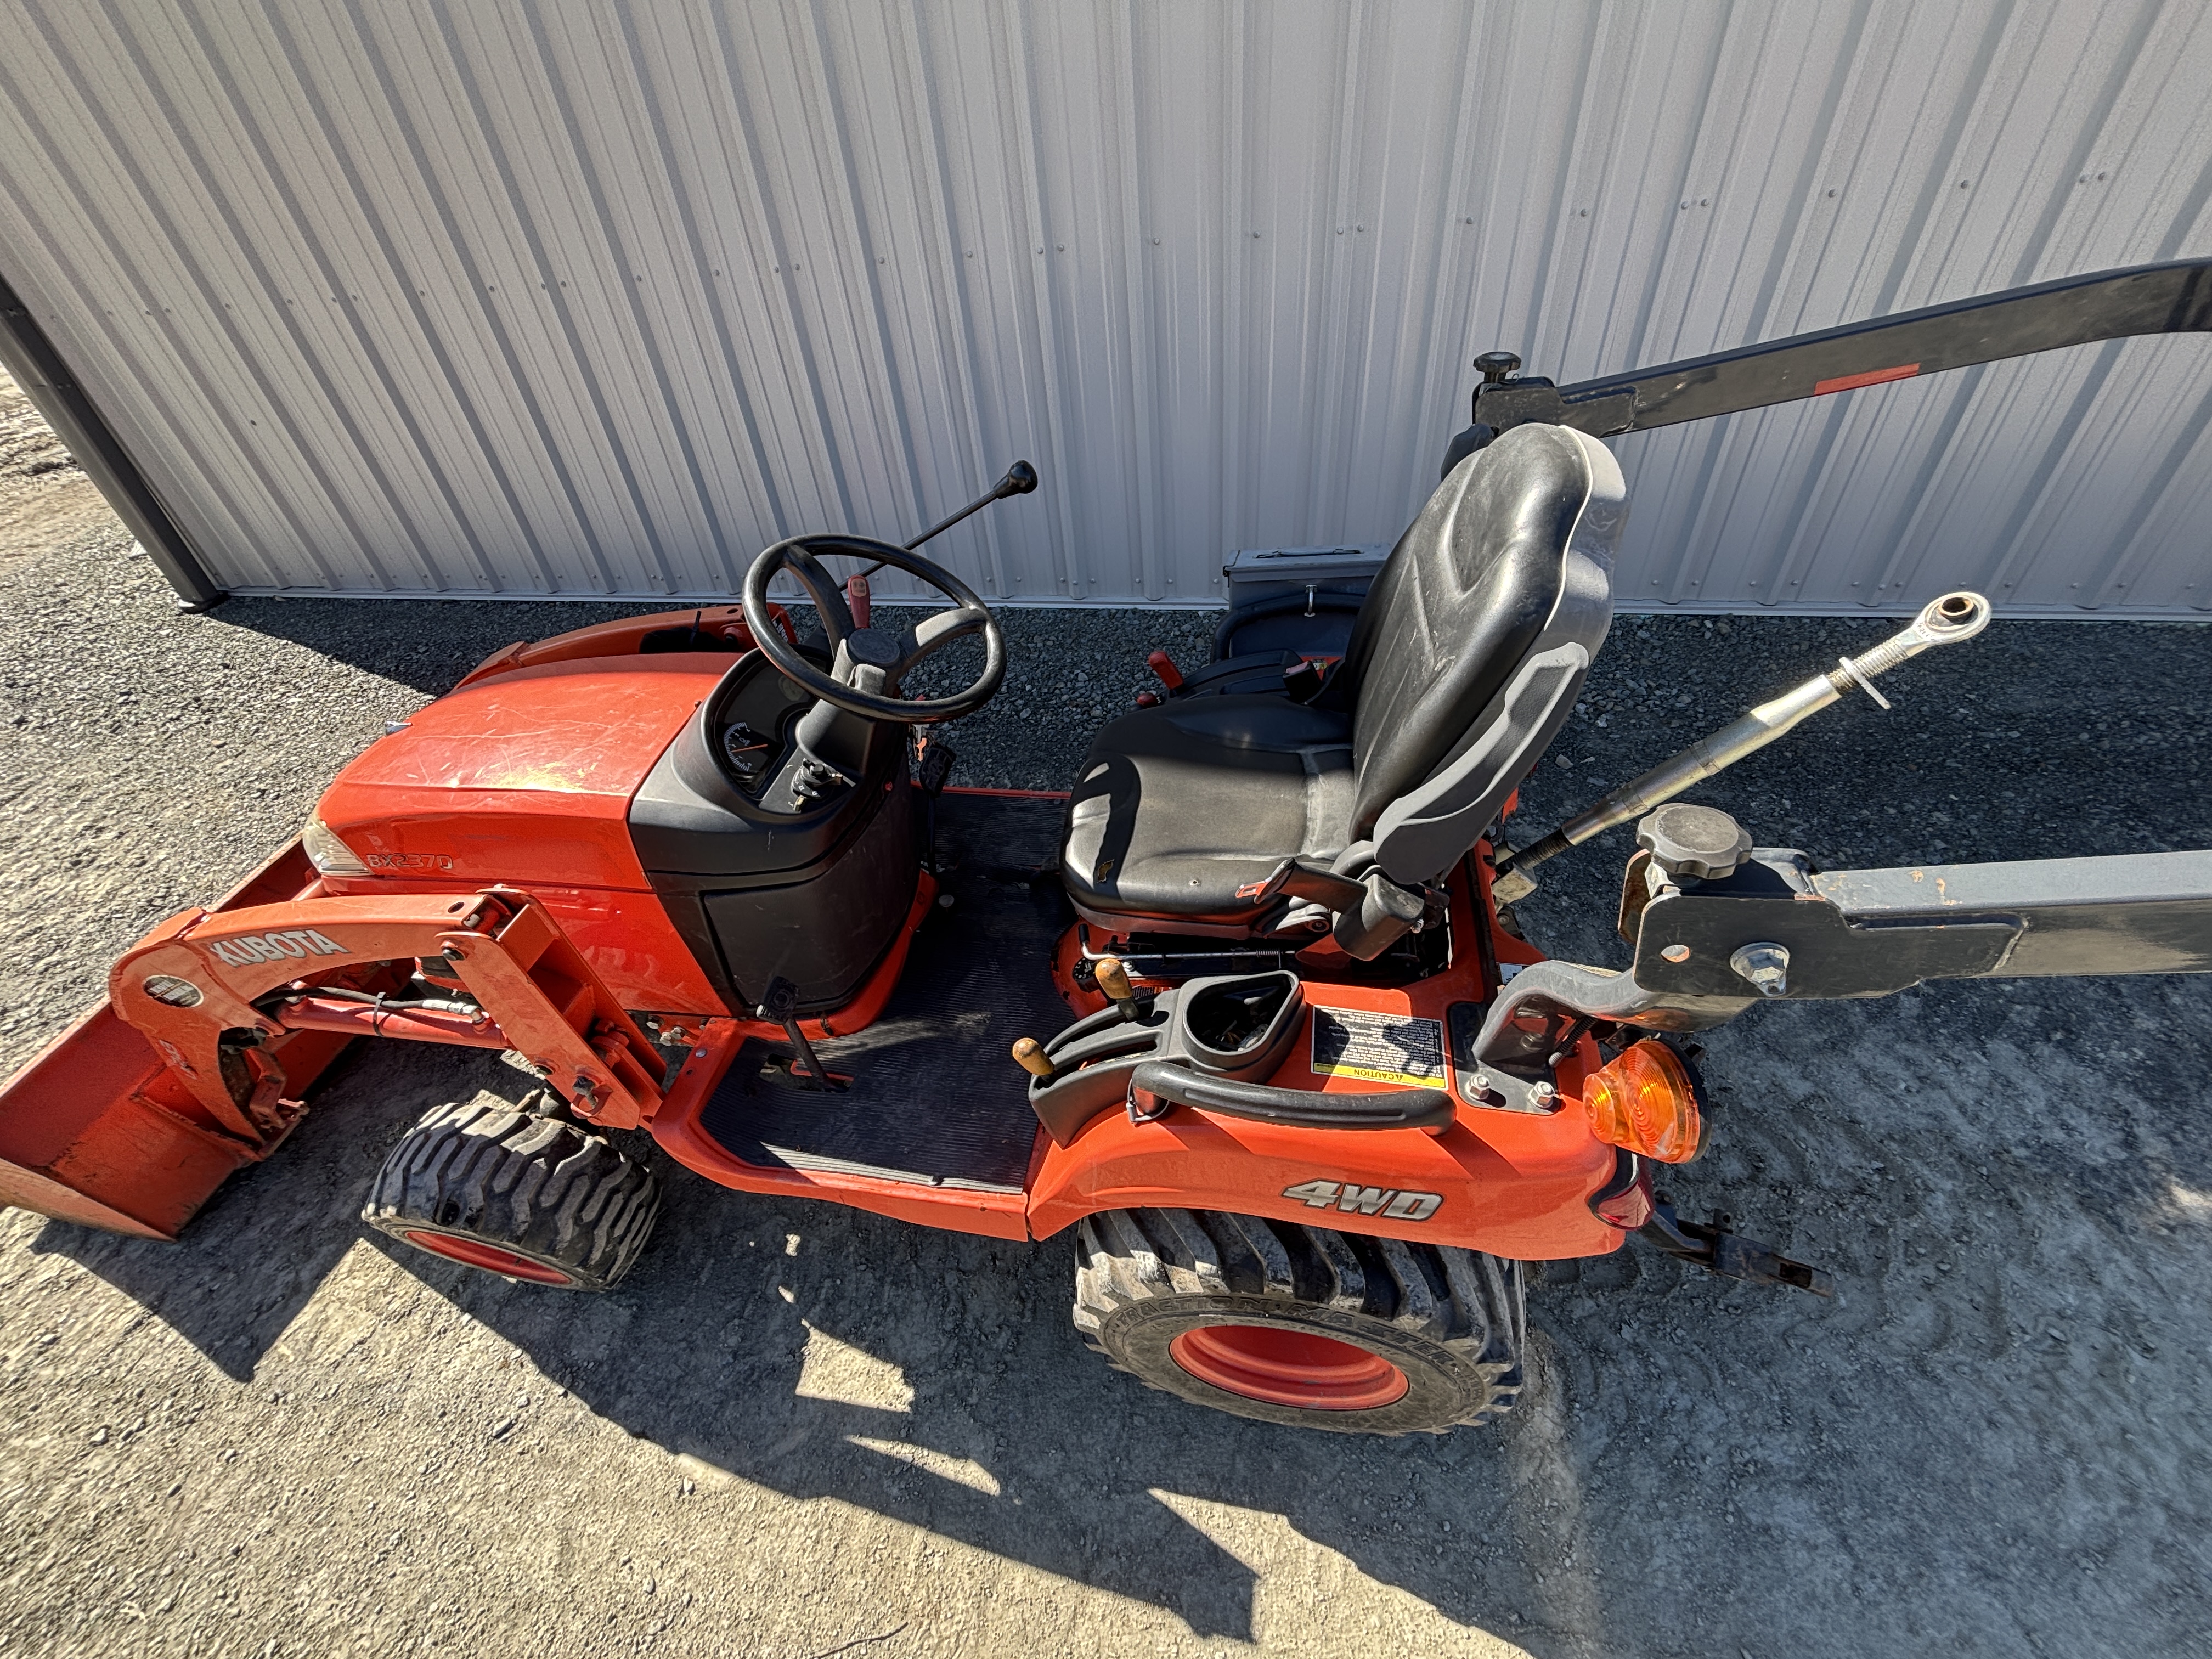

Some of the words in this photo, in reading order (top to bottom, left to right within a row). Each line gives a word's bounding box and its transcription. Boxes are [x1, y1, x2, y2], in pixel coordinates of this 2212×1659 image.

[366, 853, 454, 870] BX2370
[211, 929, 352, 968] KUBOTA
[1353, 1069, 1394, 1080] CAUTION
[1280, 1178, 1445, 1222] 4WD
[1116, 1295, 1274, 1328] TRACTION
[1286, 1302, 1457, 1367] MASTER
